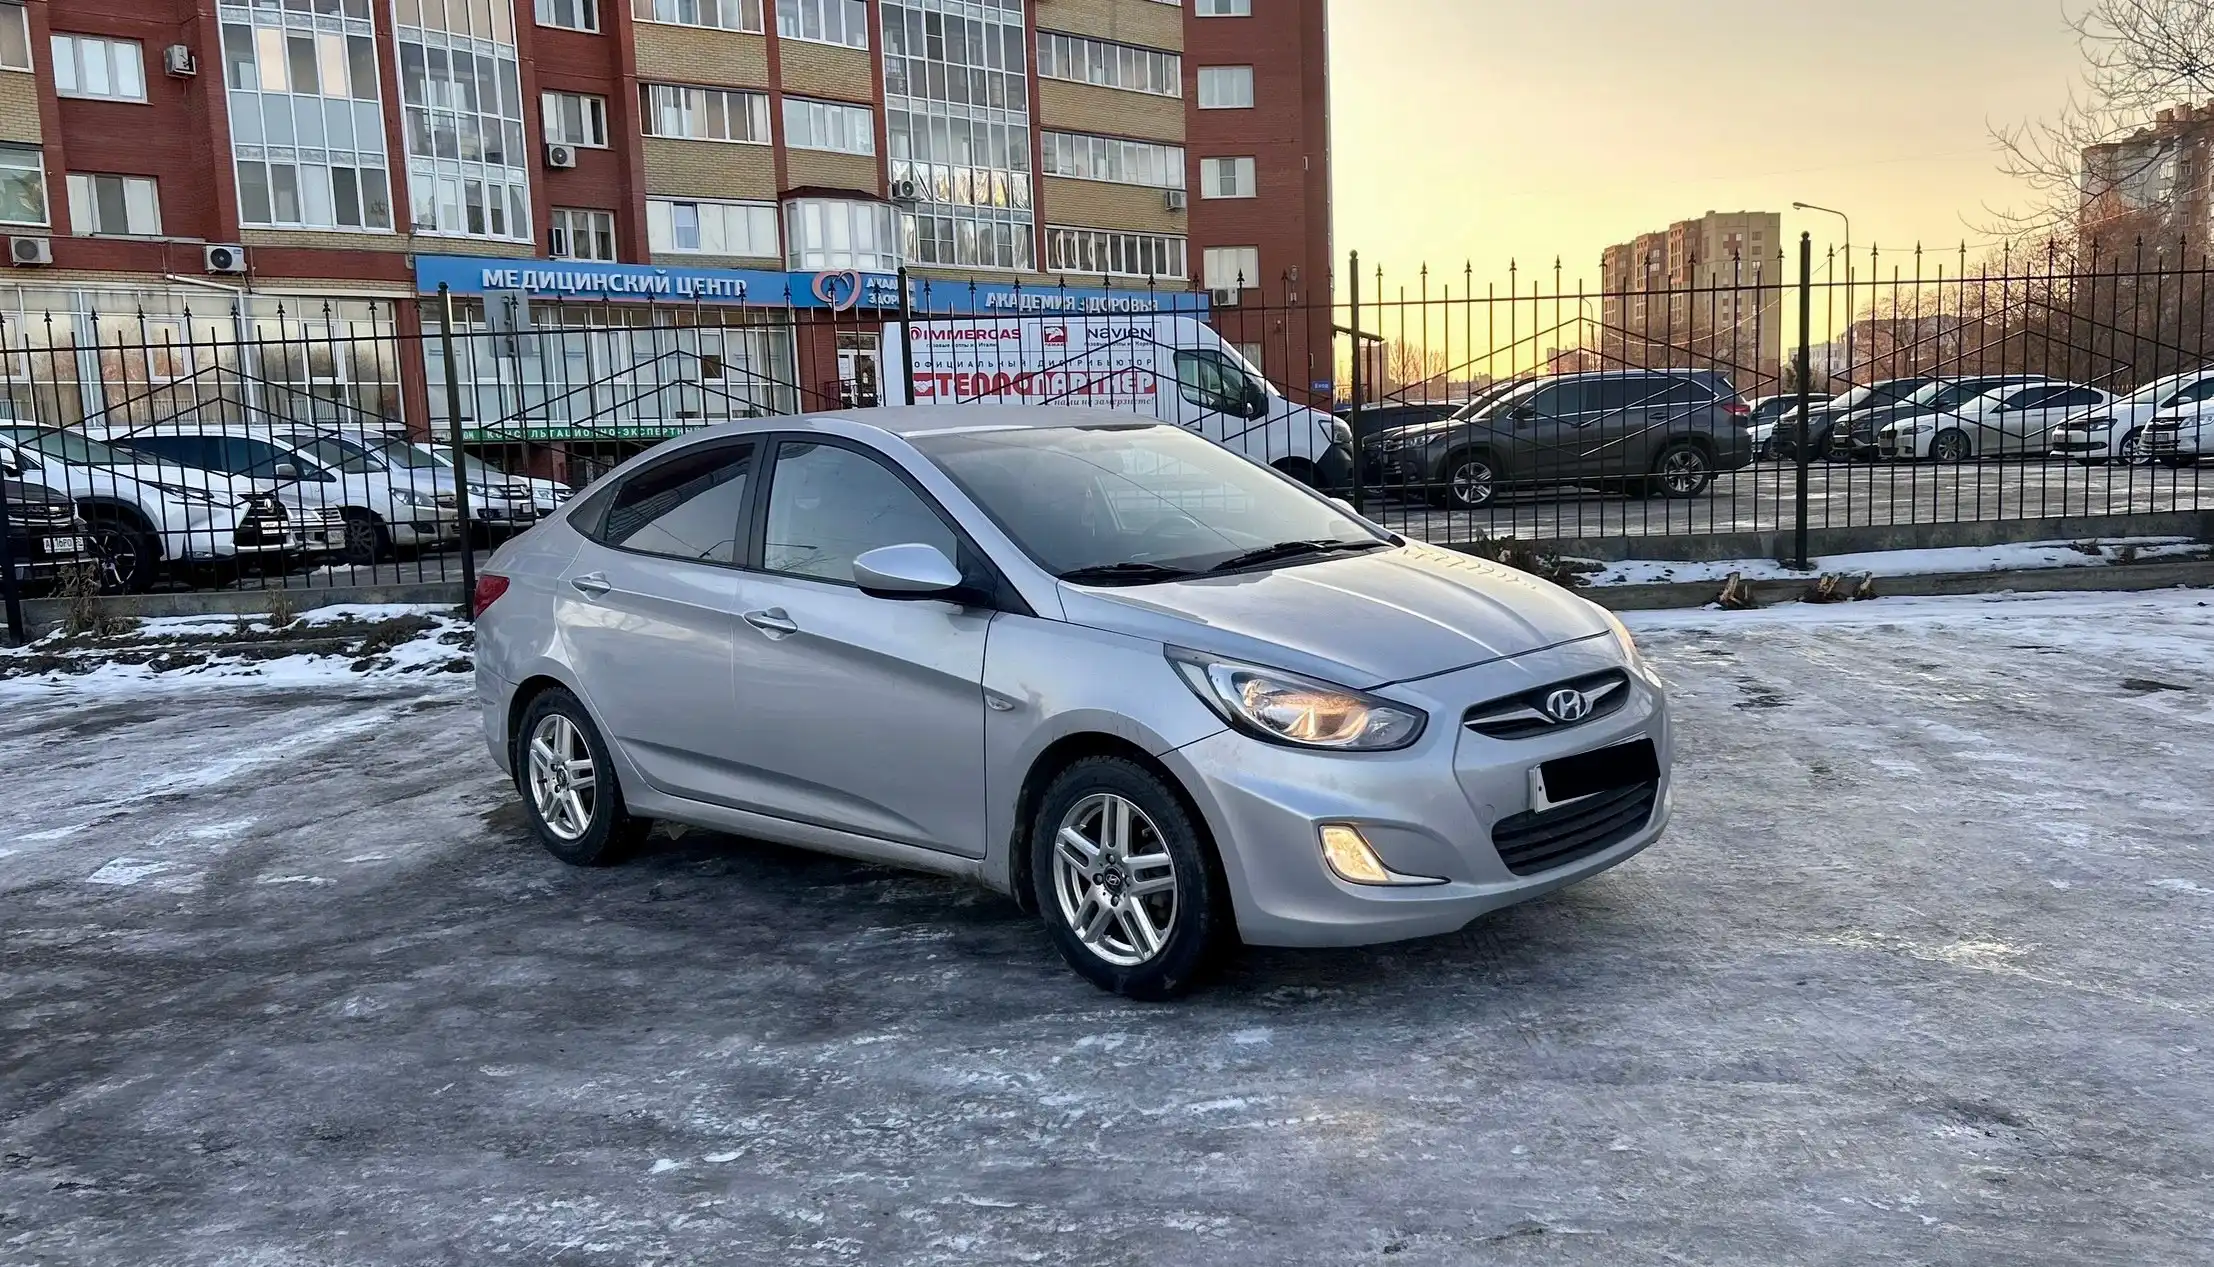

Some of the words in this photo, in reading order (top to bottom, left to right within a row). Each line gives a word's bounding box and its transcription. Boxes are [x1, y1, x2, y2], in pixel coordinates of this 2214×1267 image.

[481, 268, 671, 294] МЕДИЦИНСКИЙ
[675, 276, 748, 298] ЦЕНТР
[985, 292, 1075, 312] АКАДЕМИЯ
